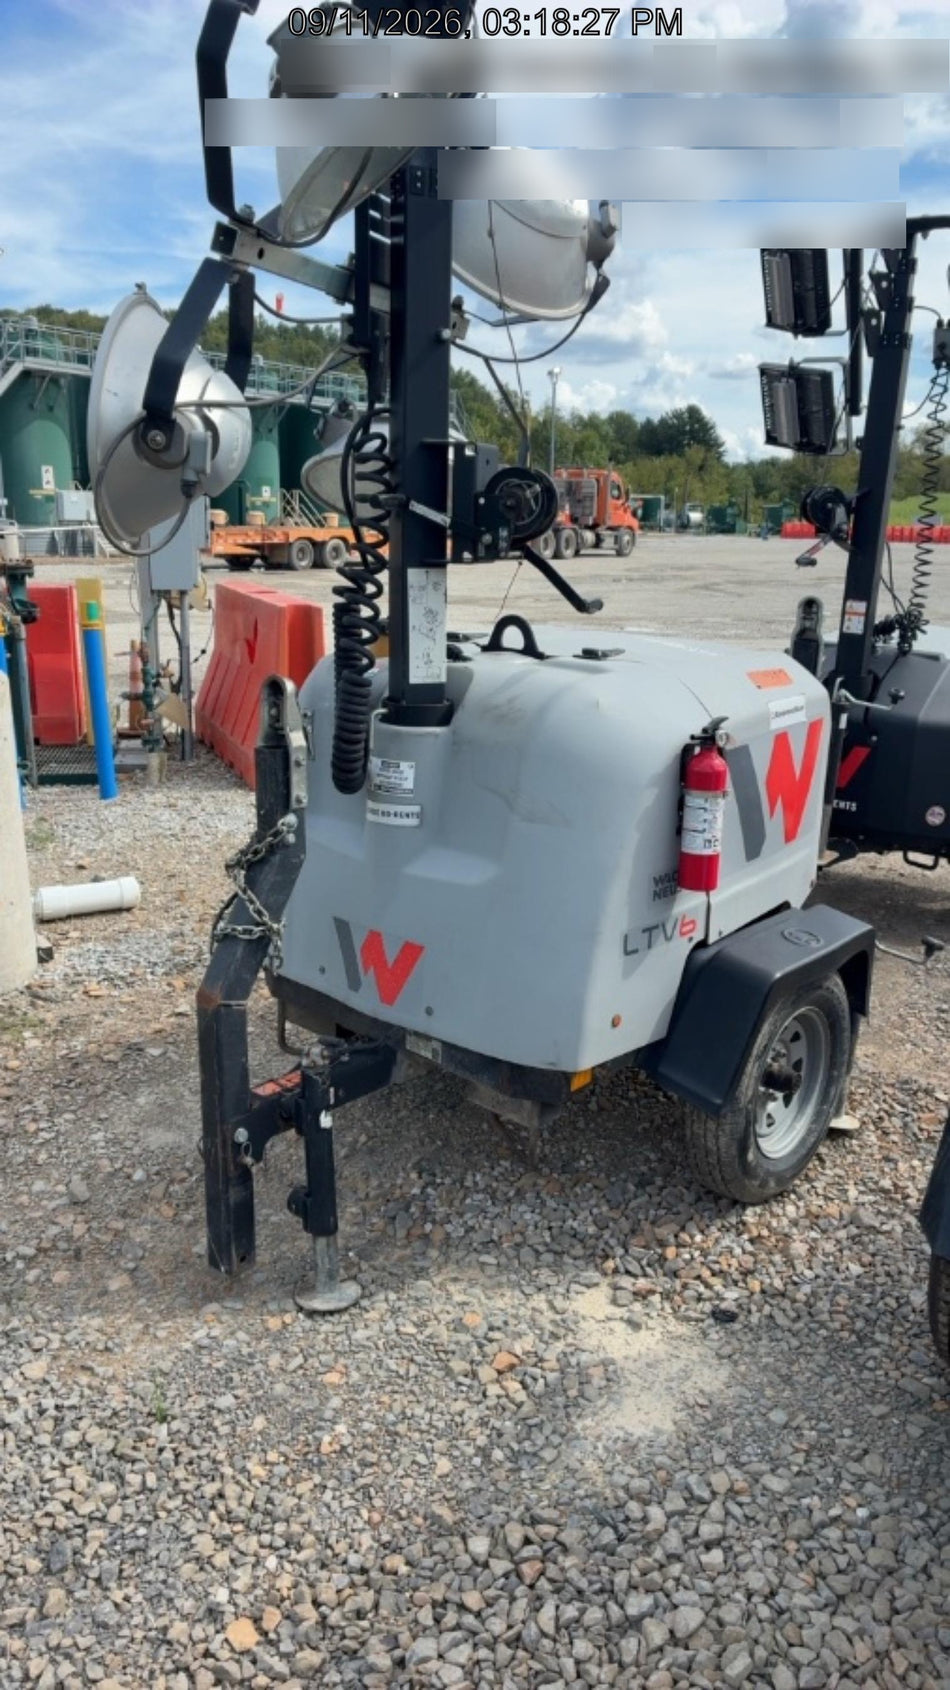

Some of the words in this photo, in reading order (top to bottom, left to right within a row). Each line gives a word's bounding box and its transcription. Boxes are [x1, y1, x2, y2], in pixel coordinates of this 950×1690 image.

[832, 799, 857, 812] ENTS
[652, 883, 679, 902] NEU
[623, 914, 696, 957] LTV6
